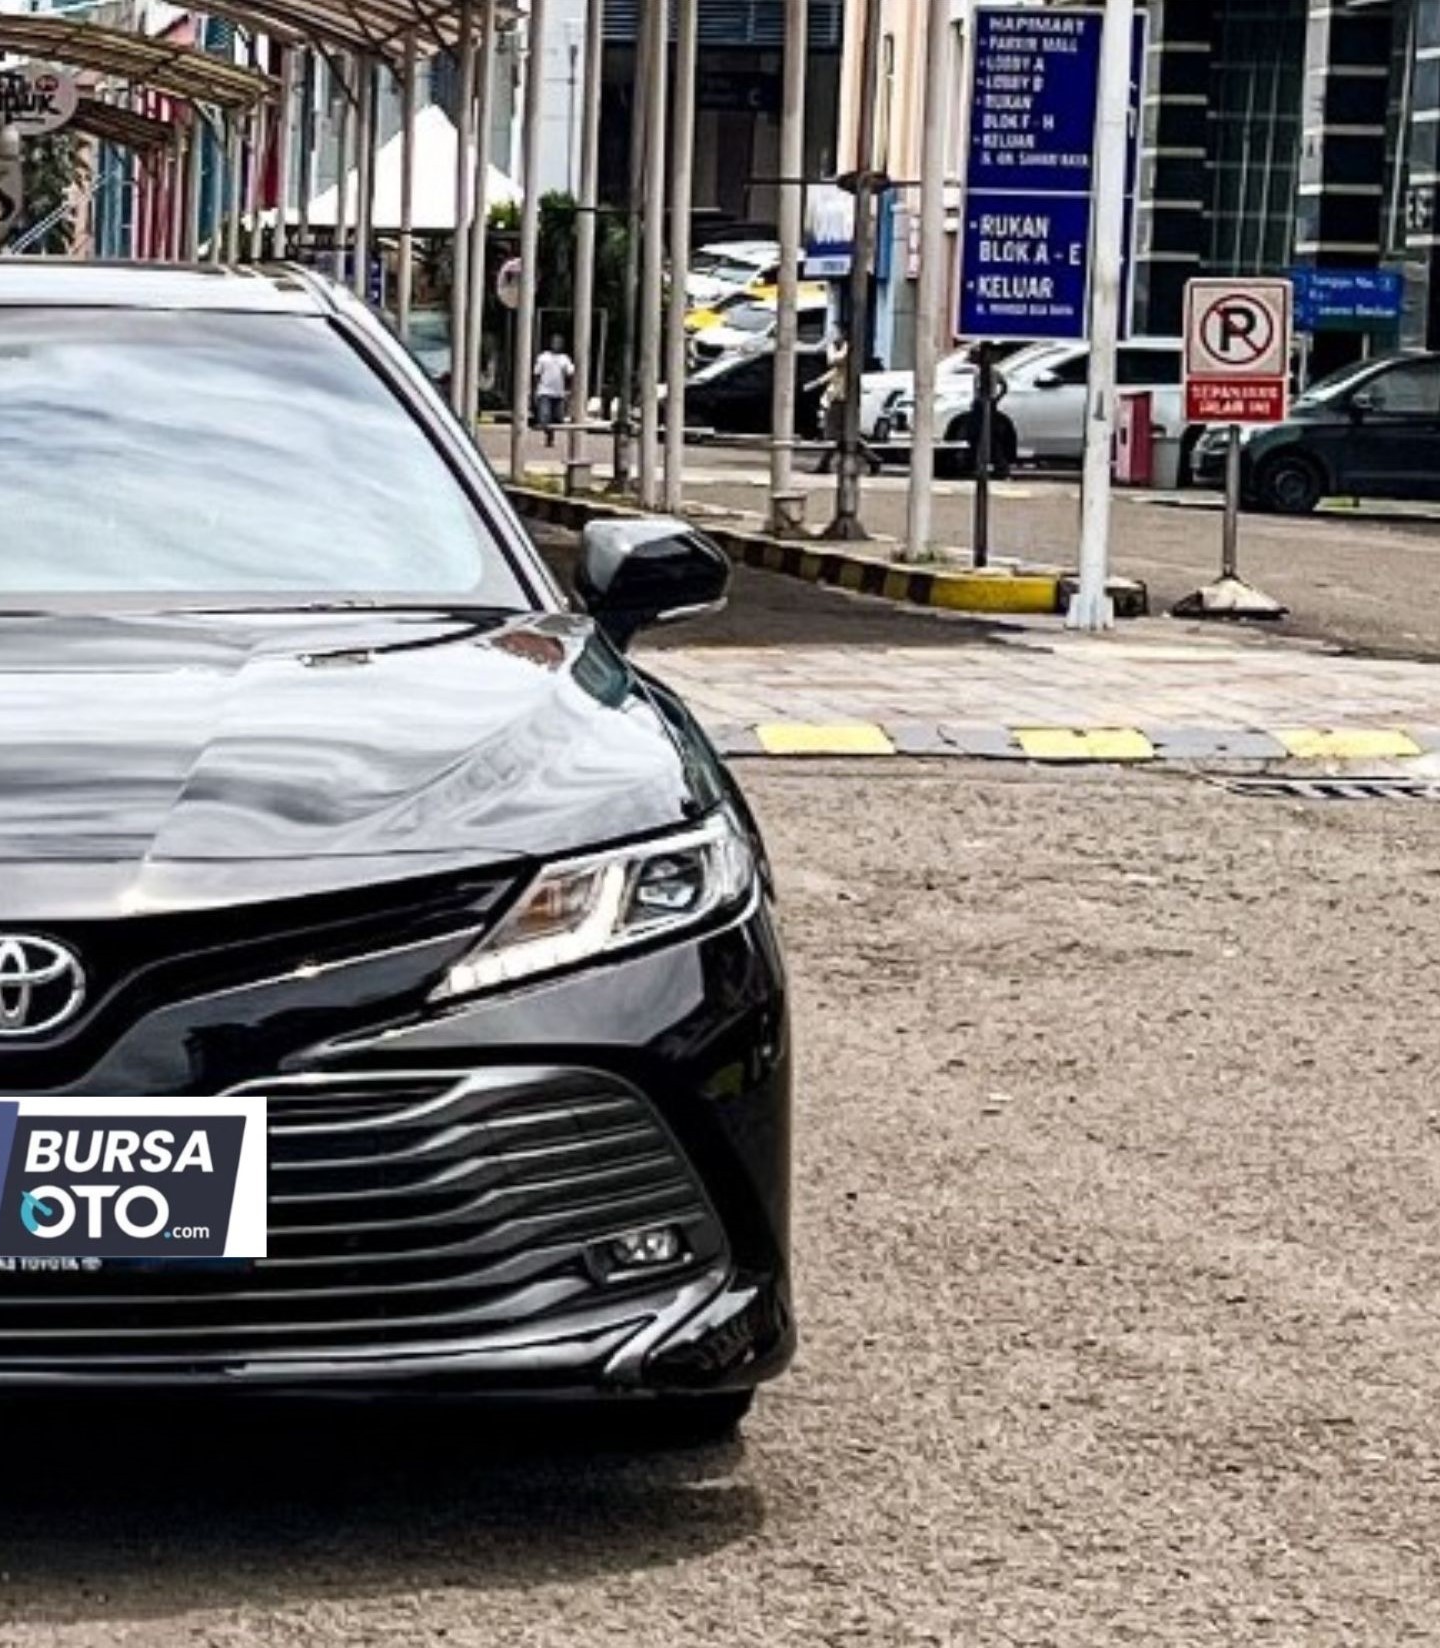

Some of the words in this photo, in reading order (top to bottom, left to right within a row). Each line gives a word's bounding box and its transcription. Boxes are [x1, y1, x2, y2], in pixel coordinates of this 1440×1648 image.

[1033, 57, 1045, 72] A
[1042, 114, 1054, 130] H
[979, 214, 1049, 239] RUKAN
[978, 240, 1030, 263] BLOK
[1032, 242, 1050, 264] A
[1068, 243, 1082, 266] E
[976, 275, 1053, 299] KELUAR
